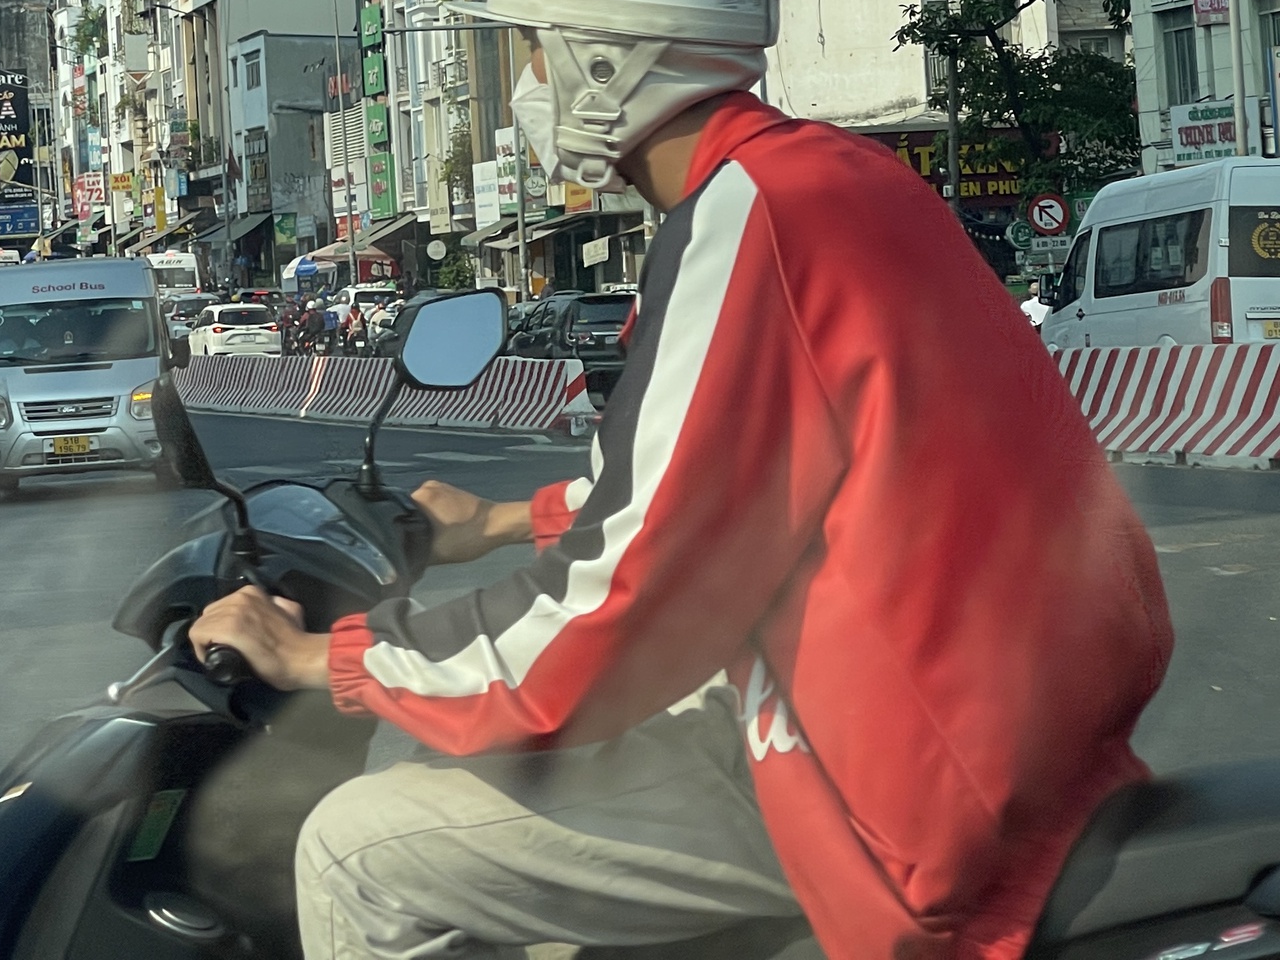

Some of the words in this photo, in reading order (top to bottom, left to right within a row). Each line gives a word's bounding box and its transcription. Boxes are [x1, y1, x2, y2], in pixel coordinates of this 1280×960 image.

[86, 188, 104, 202] 72
[32, 282, 76, 294] School
[80, 281, 105, 291] Bus
[62, 405, 76, 413] Ford
